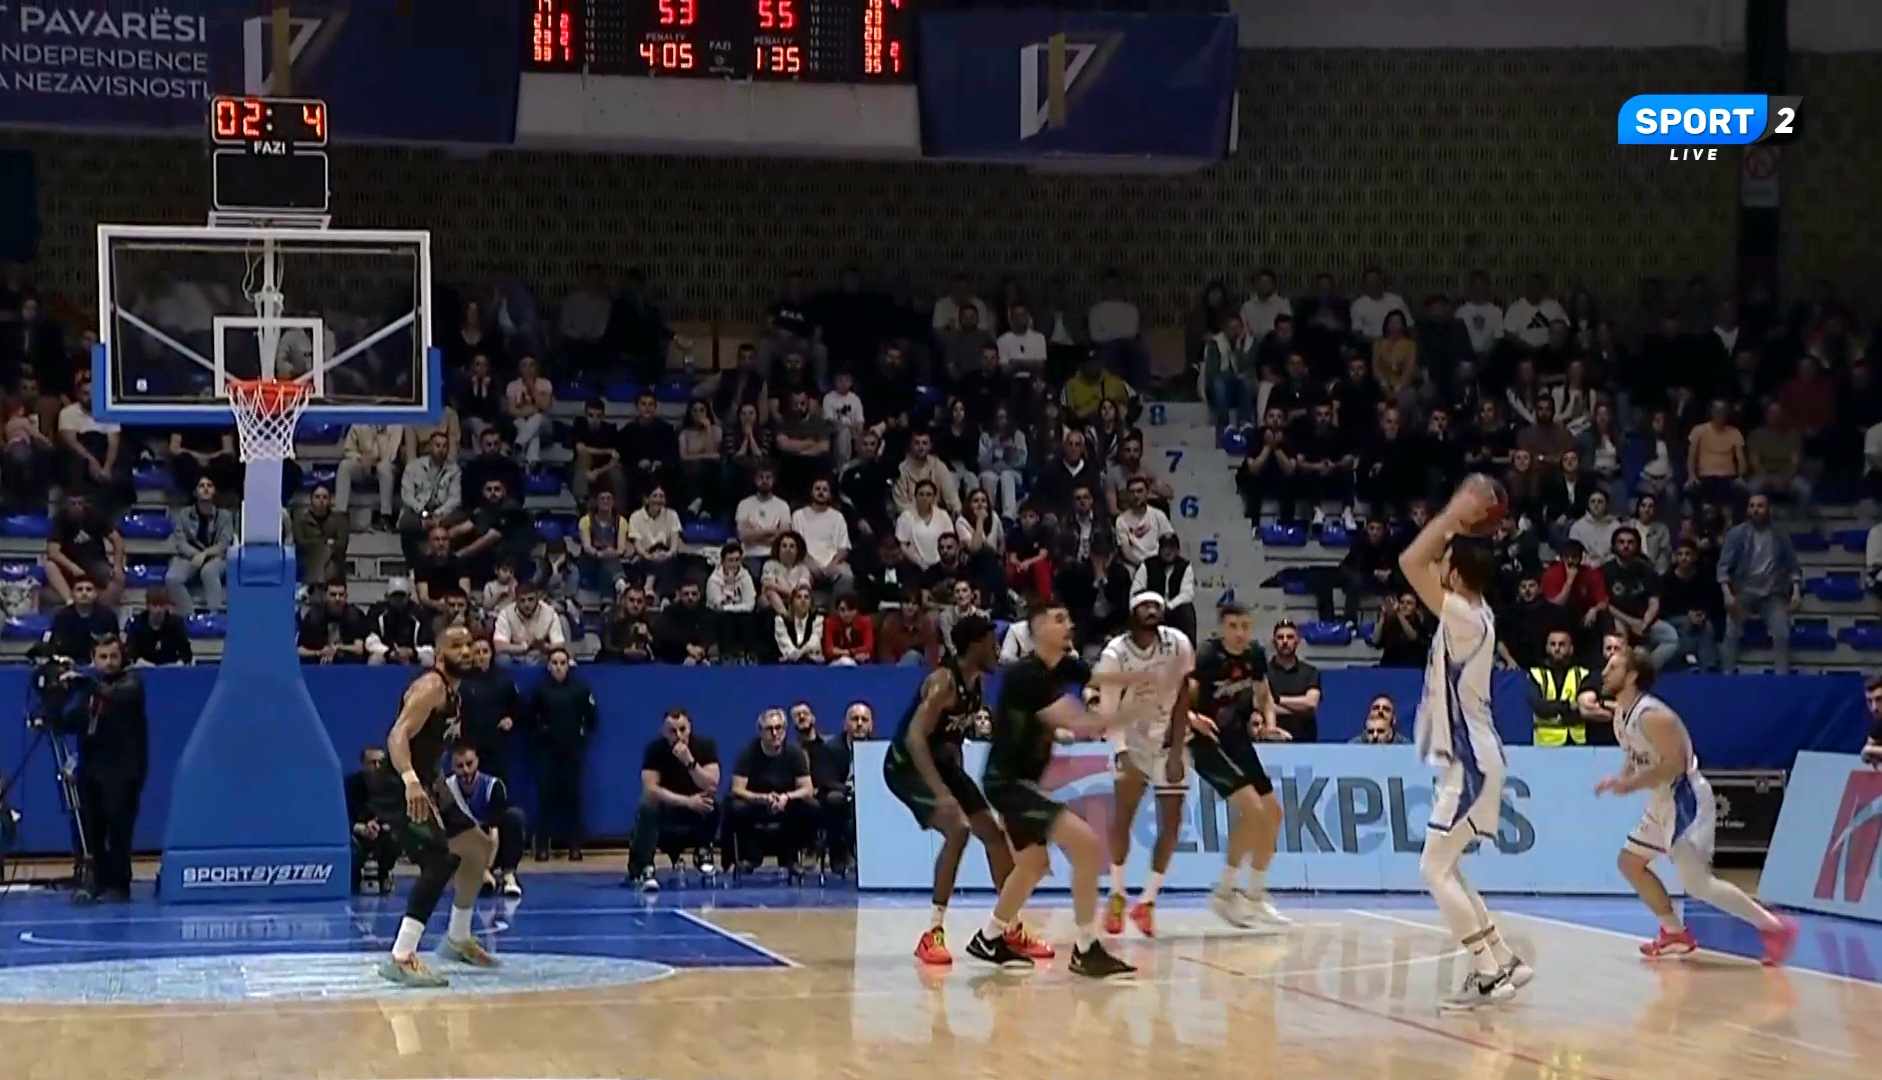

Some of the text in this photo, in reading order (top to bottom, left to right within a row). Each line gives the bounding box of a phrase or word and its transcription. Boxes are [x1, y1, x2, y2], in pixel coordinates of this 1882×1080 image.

[20, 6, 206, 42] PAVARËSI
[658, 0, 693, 25] 53
[758, 0, 793, 28] 55
[15, 72, 209, 99] NEZAVISNOSTI
[254, 141, 286, 155] FAZI
[1166, 450, 1183, 473] 7
[1180, 495, 1199, 518] 6
[1200, 541, 1218, 565] 5
